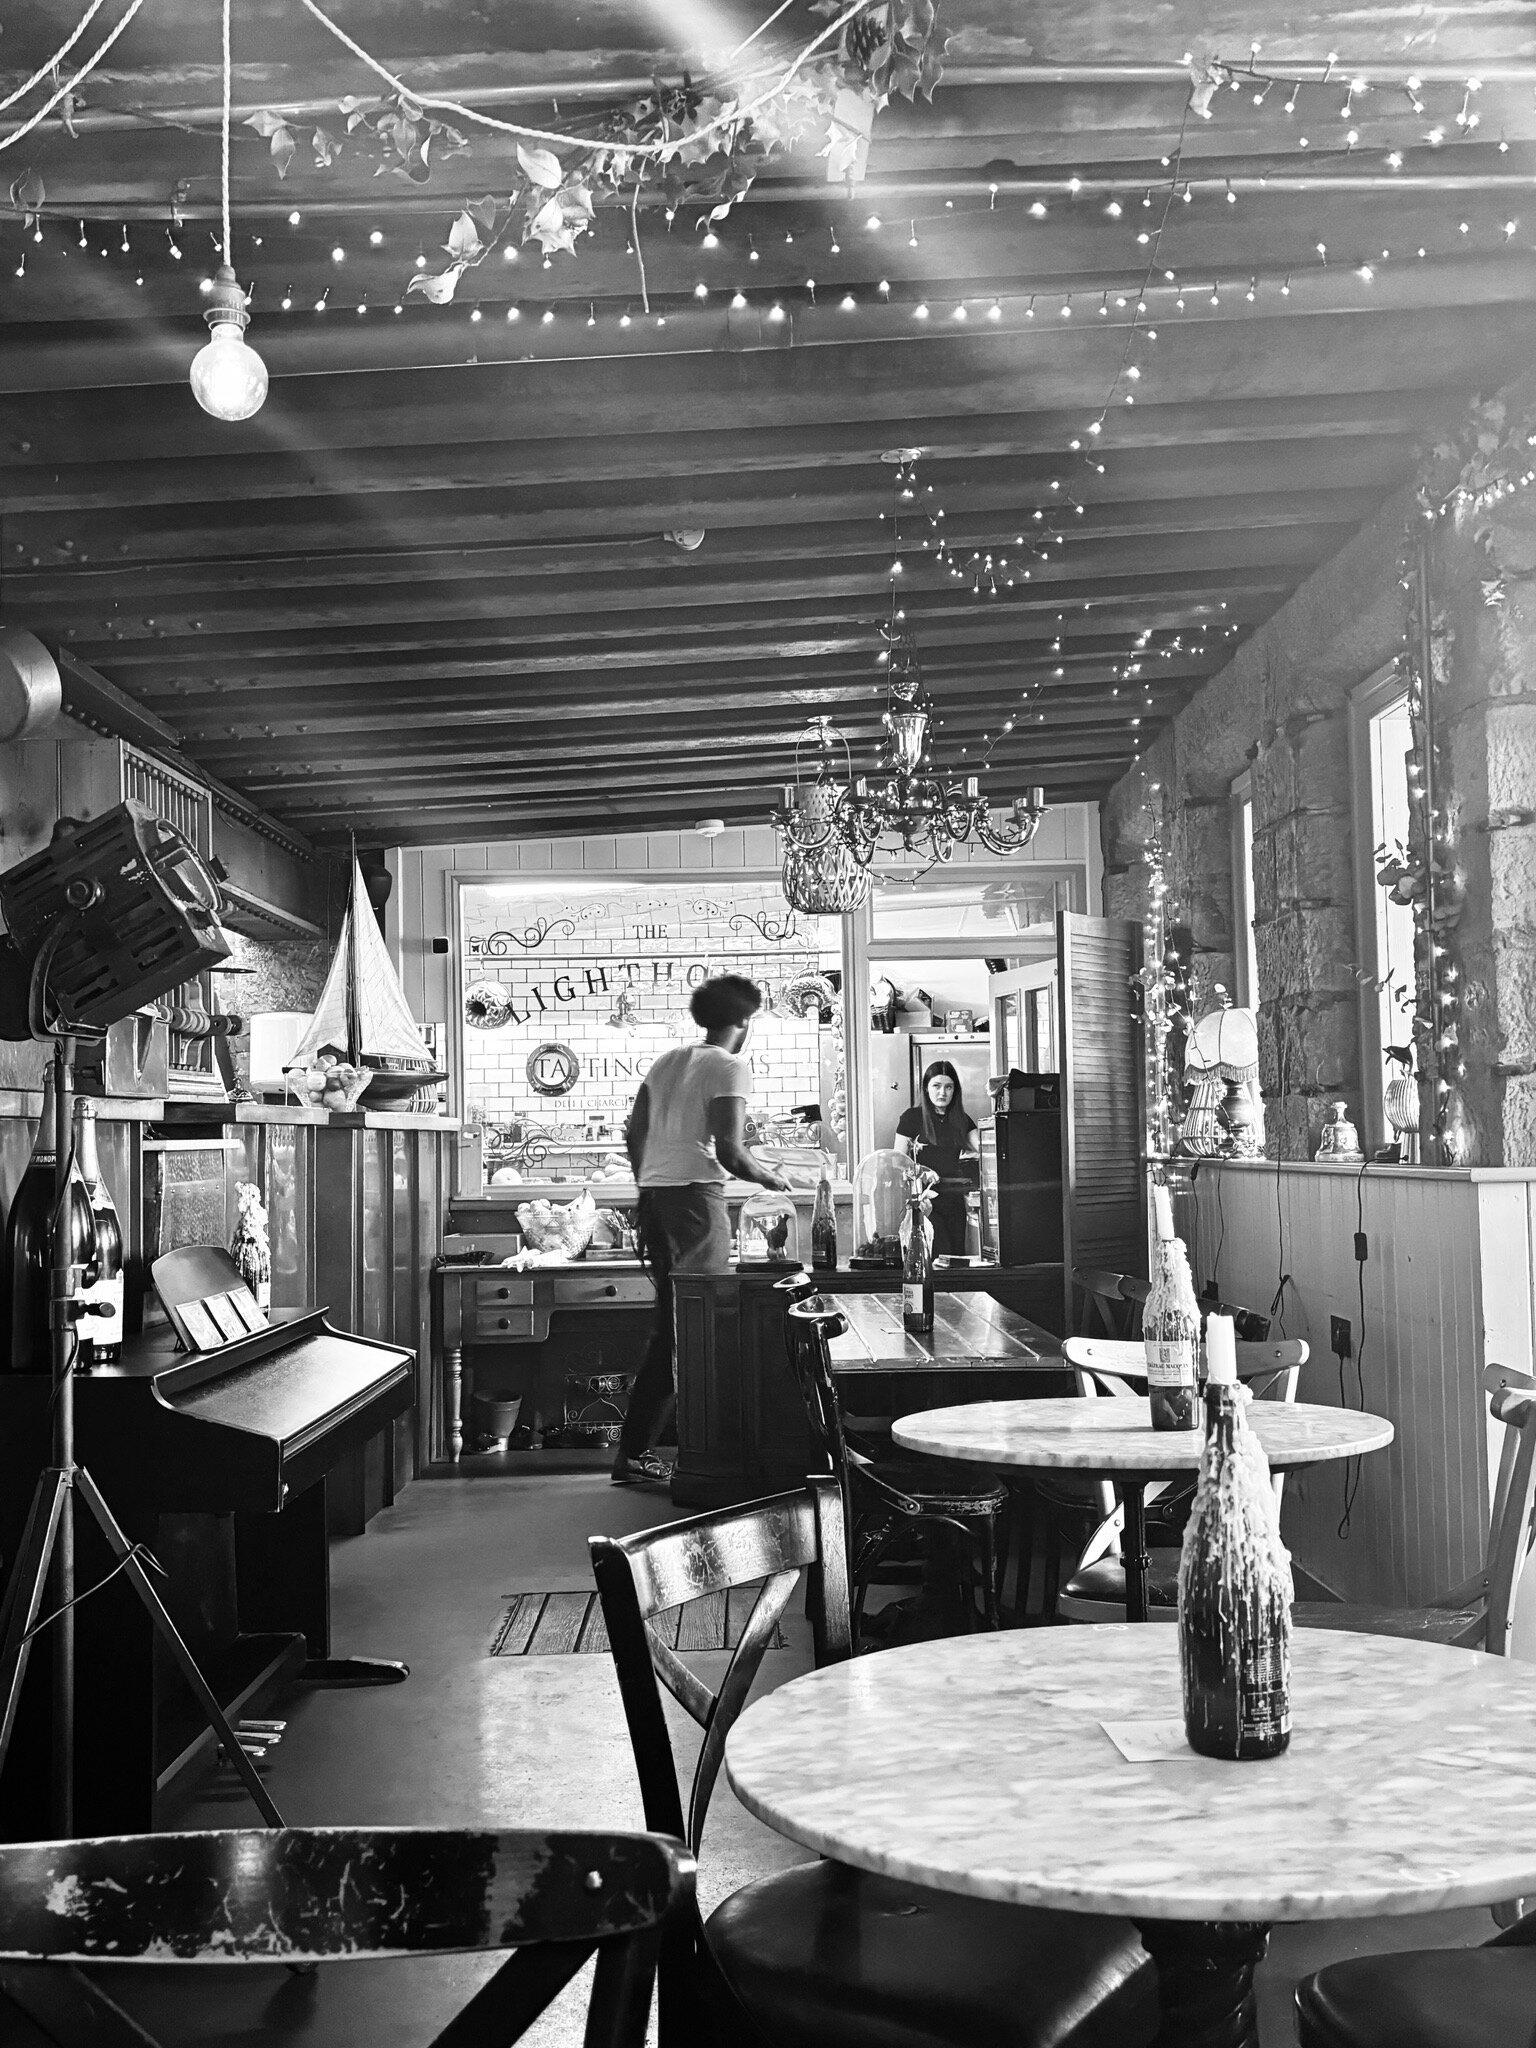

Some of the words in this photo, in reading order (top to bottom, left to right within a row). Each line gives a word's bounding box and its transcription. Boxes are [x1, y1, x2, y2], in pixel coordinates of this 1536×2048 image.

[632, 924, 667, 938] THE
[505, 962, 709, 1025] LIGHTHO
[536, 1057, 653, 1078] TATING
